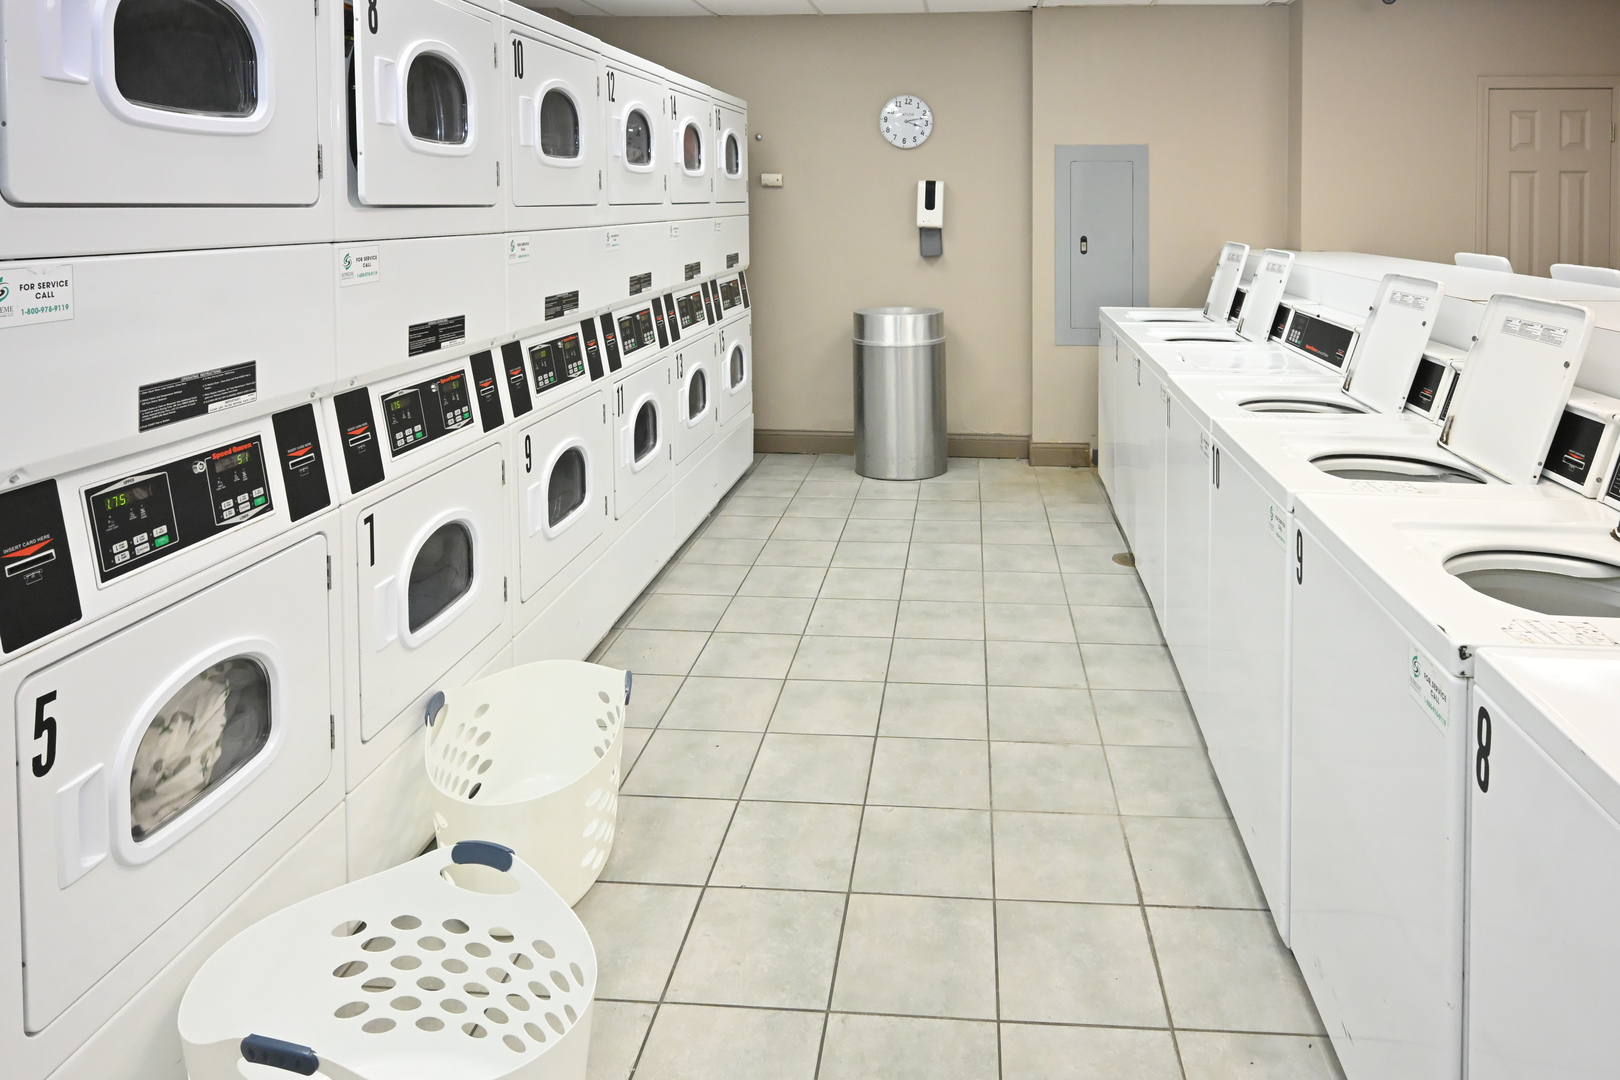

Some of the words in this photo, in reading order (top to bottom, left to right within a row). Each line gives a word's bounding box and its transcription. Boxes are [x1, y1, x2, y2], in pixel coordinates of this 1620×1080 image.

[512, 38, 524, 79] 10
[606, 71, 615, 102] 12
[670, 95, 677, 120] 14
[895, 100, 902, 108] 11
[19, 283, 35, 291] FOR
[37, 280, 69, 290] SERVICE
[35, 291, 55, 300] CALL
[21, 304, 70, 315] 1-800-978-9119
[676, 353, 683, 379] 13
[617, 384, 624, 418] 11
[211, 448, 233, 460] Speed
[232, 442, 253, 453] Queen
[525, 434, 532, 474] 9
[1212, 444, 1220, 489] 10
[3, 544, 22, 554] INSERT
[22, 538, 37, 548] CARD
[37, 533, 50, 543] HERE
[1296, 528, 1303, 586] 9
[32, 689, 57, 778] 5
[1476, 706, 1492, 793] 8
